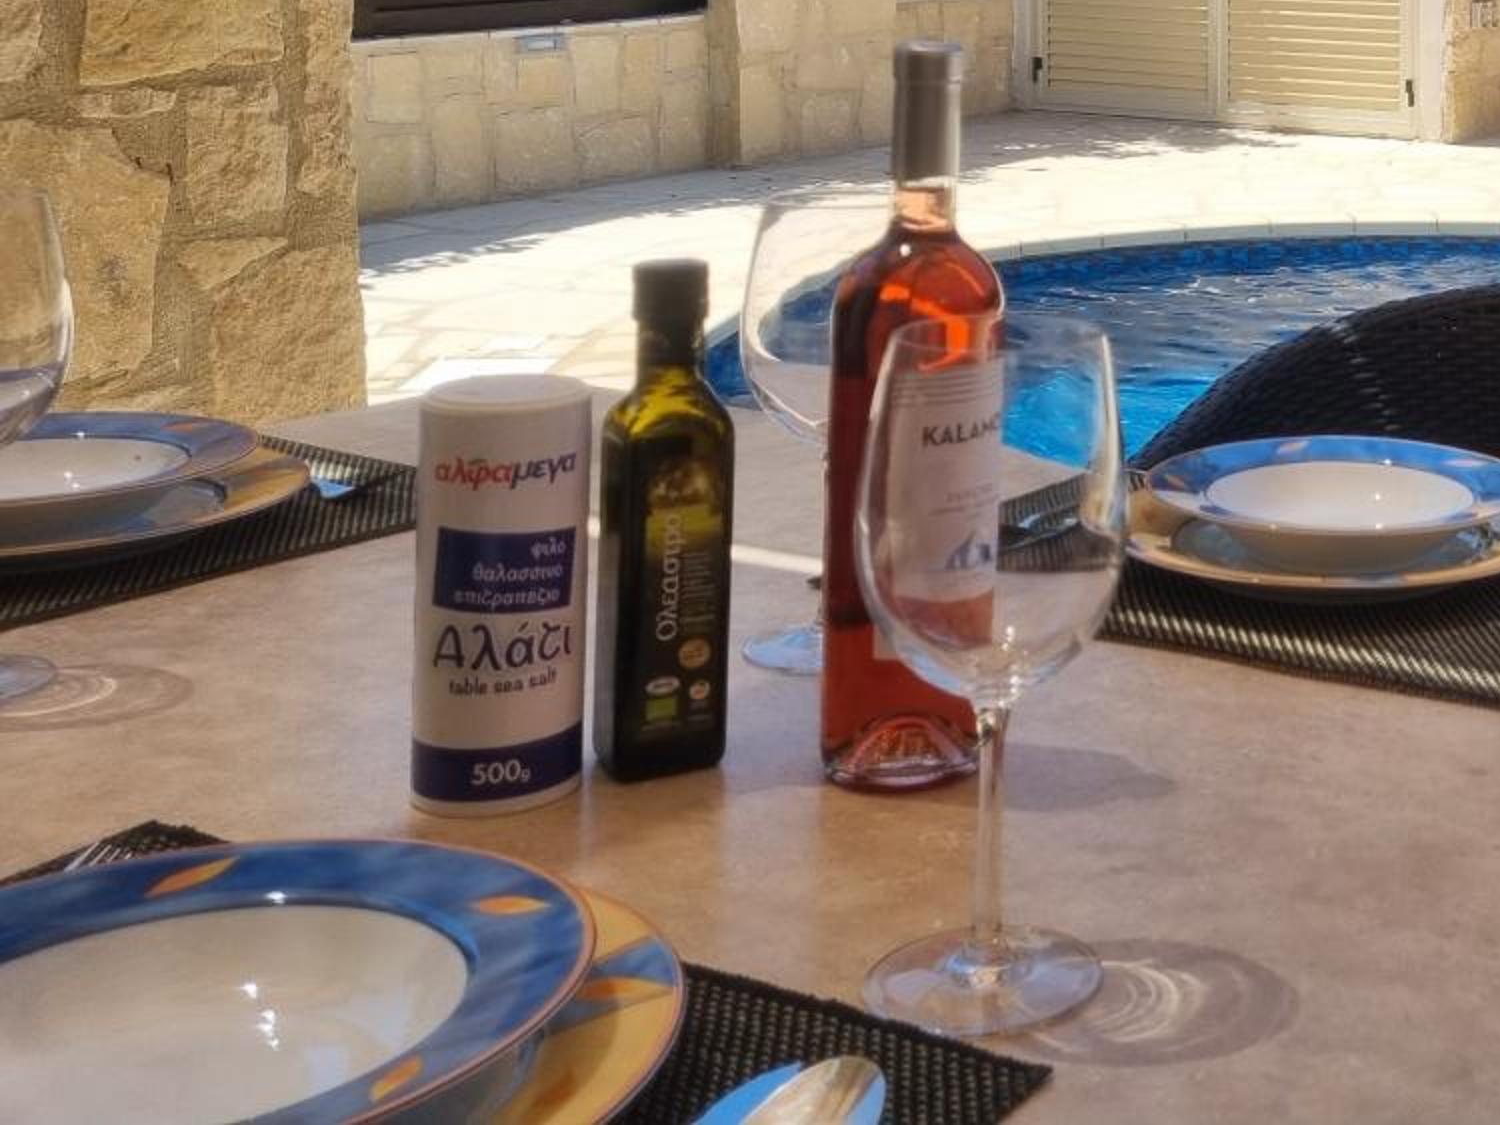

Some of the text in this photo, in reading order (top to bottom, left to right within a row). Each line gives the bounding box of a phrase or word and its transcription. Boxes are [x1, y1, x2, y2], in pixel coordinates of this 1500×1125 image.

[433, 620, 572, 671] Αλάτι
[449, 666, 557, 696] table sea salt
